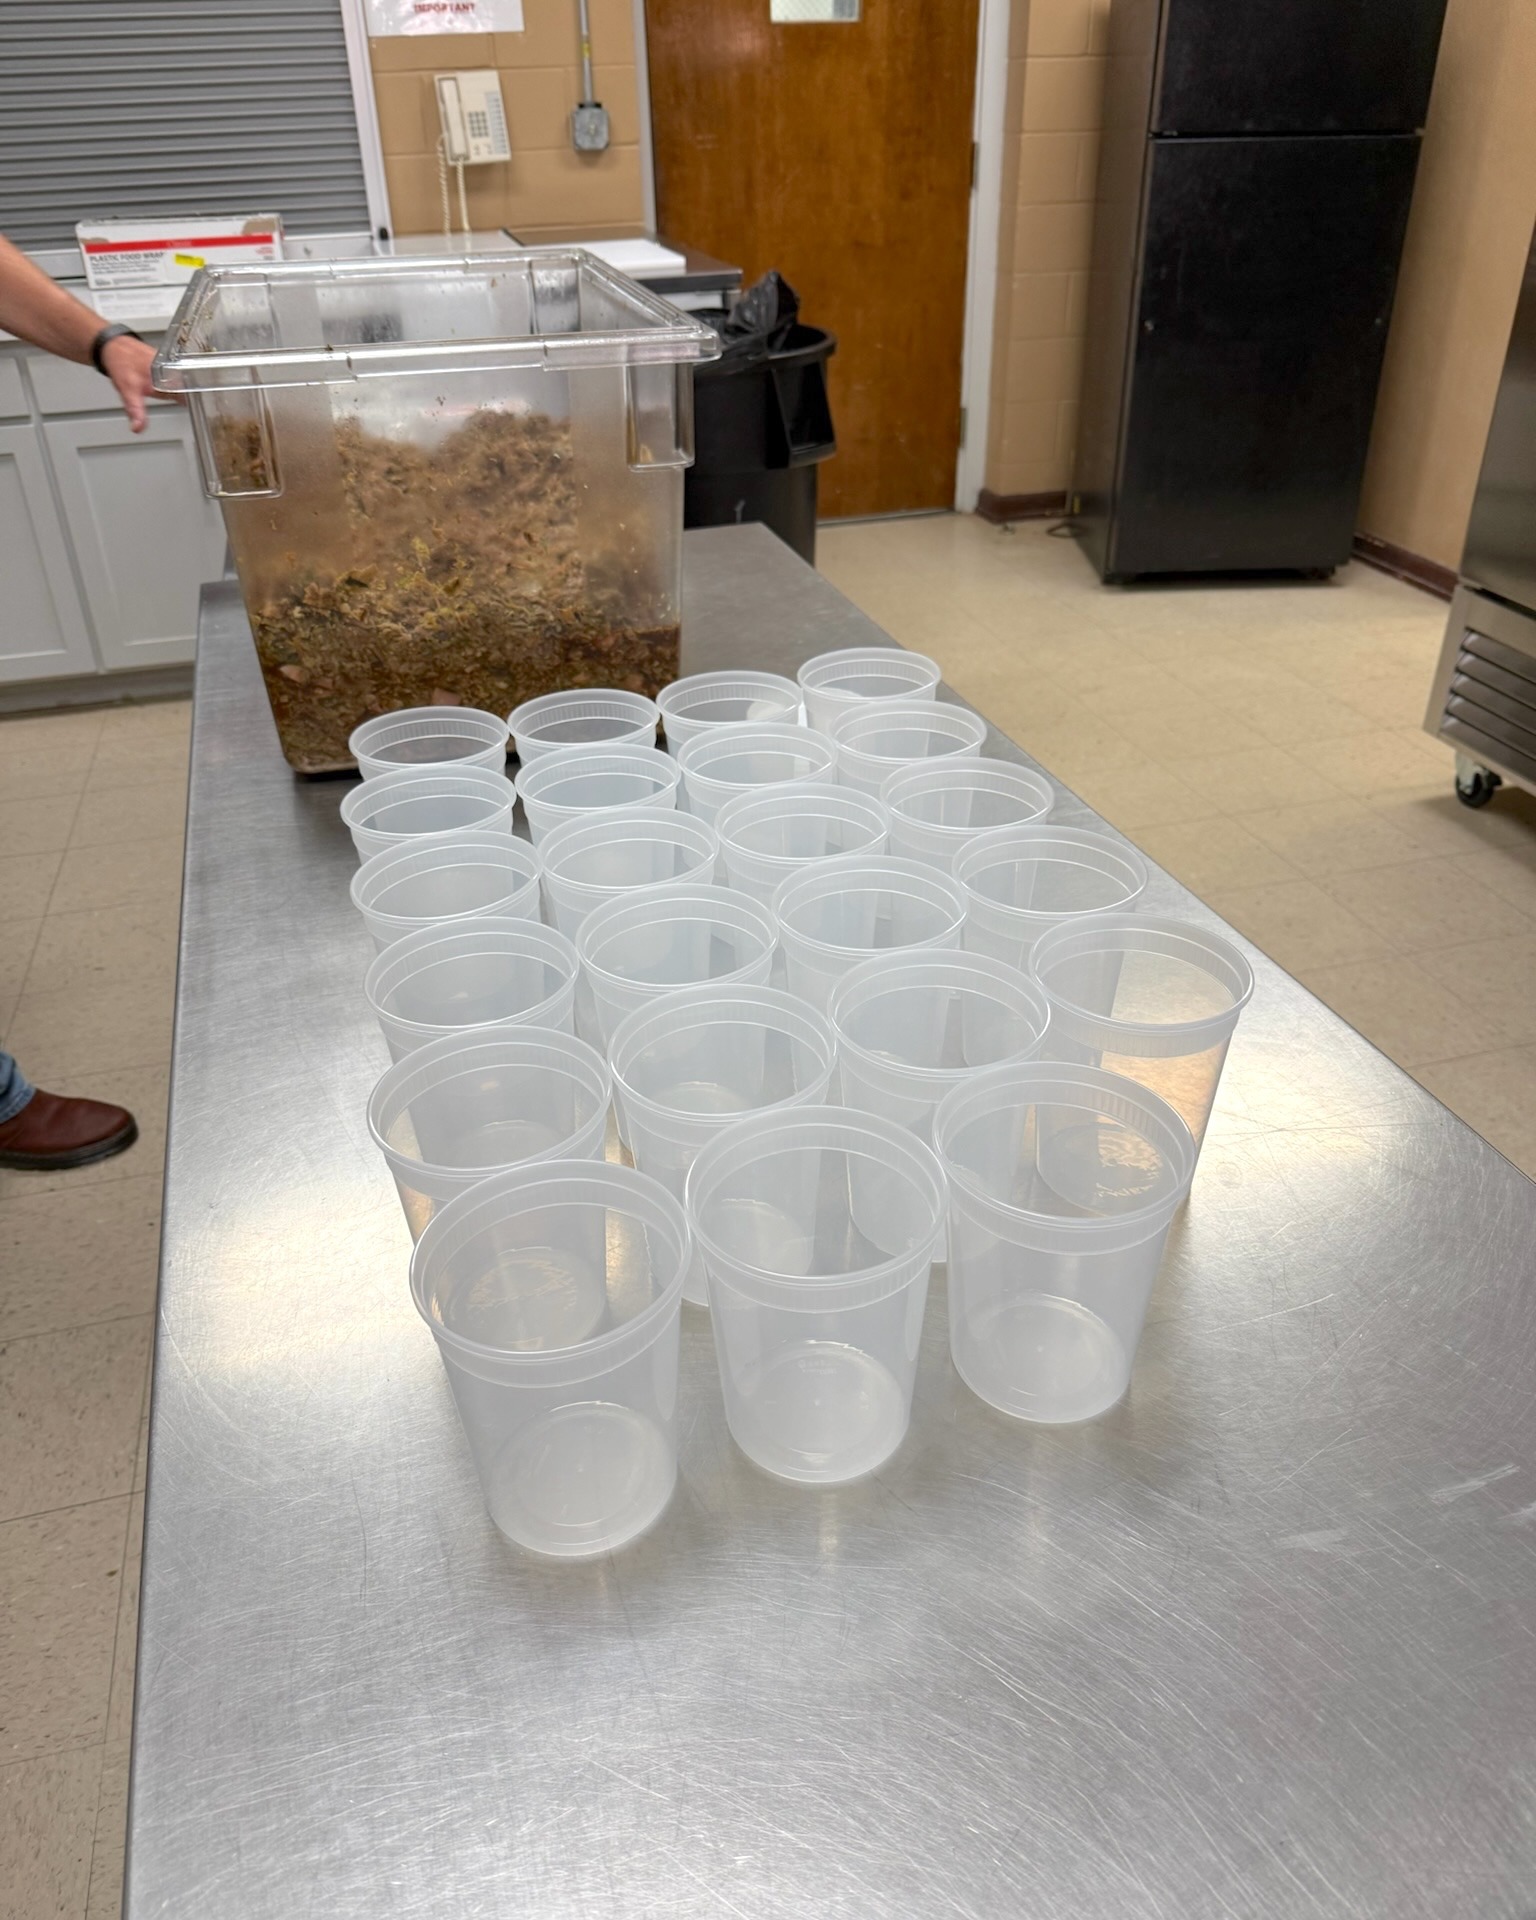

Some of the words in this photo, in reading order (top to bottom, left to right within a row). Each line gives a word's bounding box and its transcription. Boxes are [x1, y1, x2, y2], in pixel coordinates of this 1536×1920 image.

[414, 3, 475, 13] IMPORTANT
[89, 254, 119, 262] PLASTIC
[143, 251, 164, 259] WRAP
